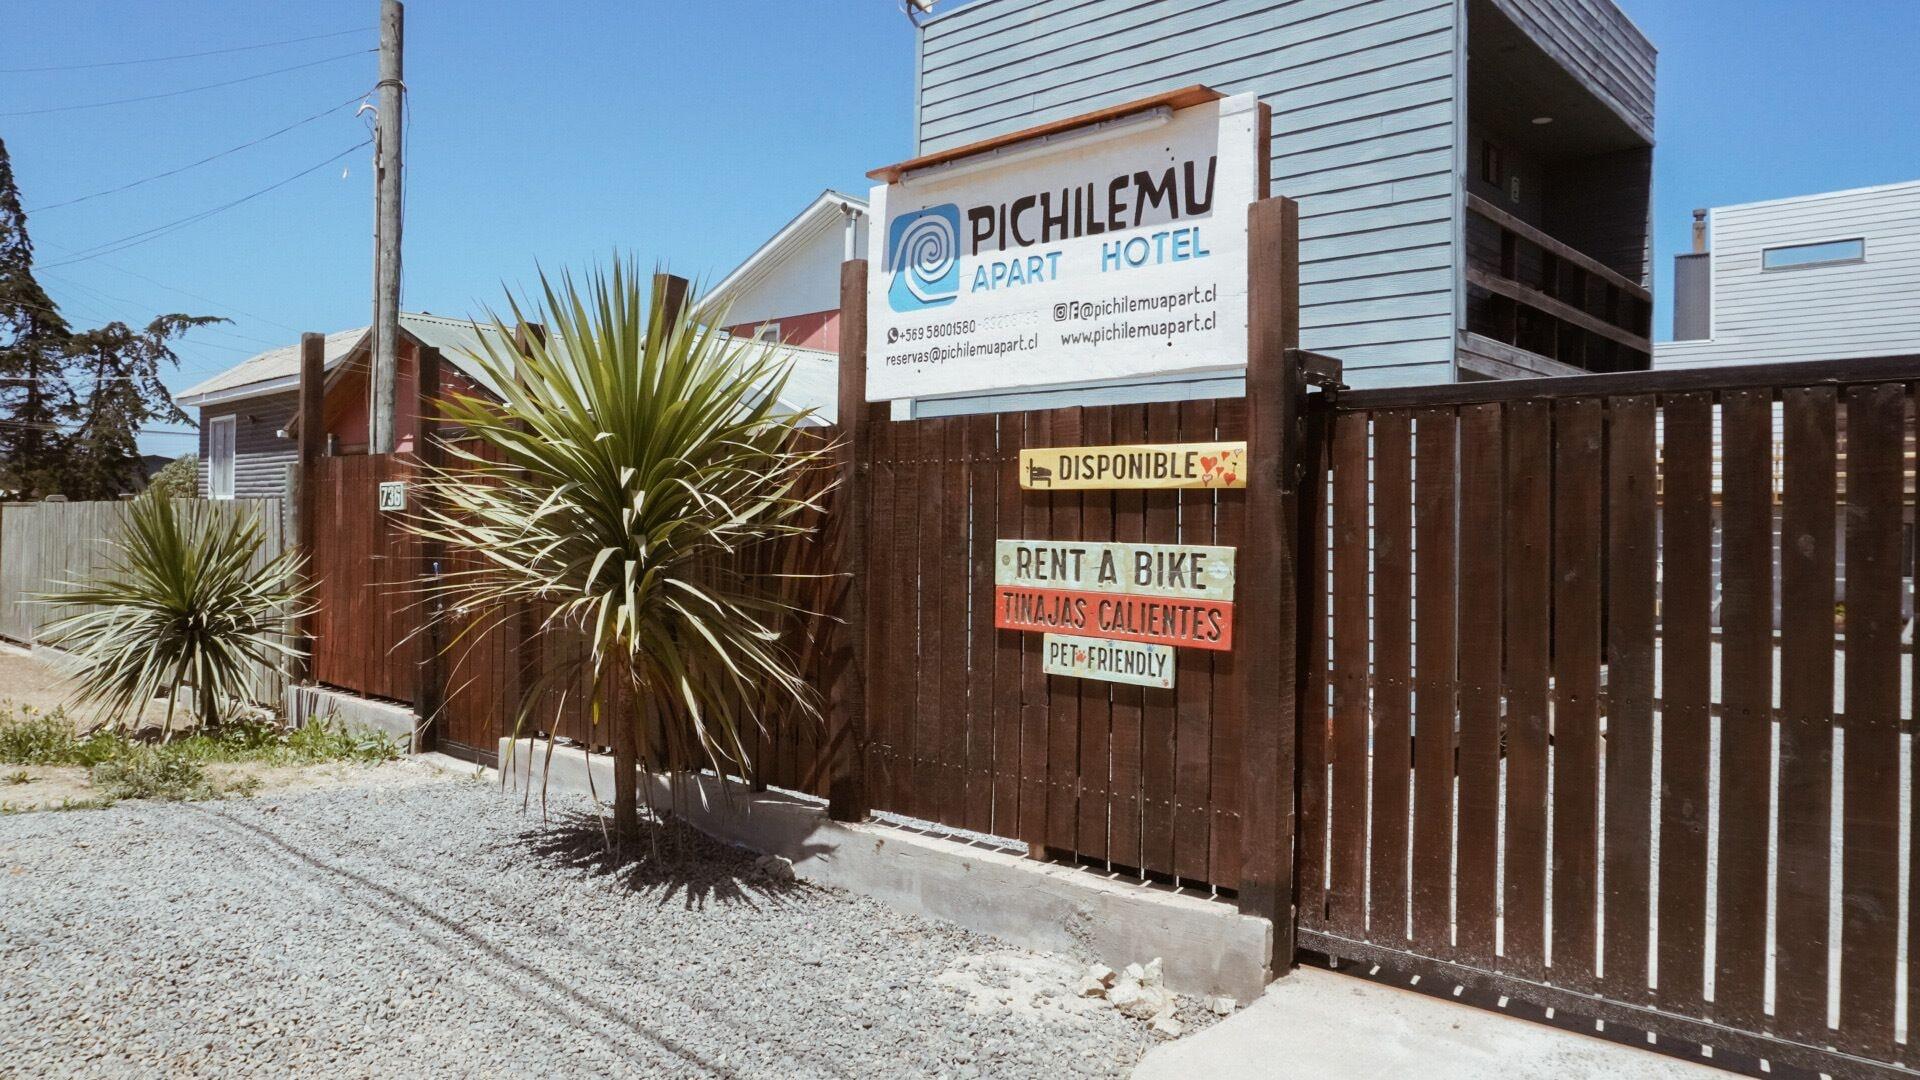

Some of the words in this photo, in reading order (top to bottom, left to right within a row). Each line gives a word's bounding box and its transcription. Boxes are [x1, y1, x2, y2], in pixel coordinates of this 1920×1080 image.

[967, 155, 1217, 256] PICHILEMU
[971, 251, 1063, 293] APART
[1101, 226, 1210, 272] HOTEL
[899, 327, 924, 342] +569
[926, 319, 976, 339] 58001580
[1061, 311, 1216, 346] www.pichilemuapart.cl
[886, 332, 1038, 366] reservas@pichilemuapart.cl
[1058, 451, 1199, 481] DISPONIBLE
[381, 484, 402, 507] 736
[1015, 546, 1086, 582] RENT
[1097, 549, 1118, 586] A
[1134, 551, 1207, 590] BIKE
[1003, 592, 1088, 630] TINAJAS
[1099, 600, 1222, 643] CALIENTES
[1050, 642, 1078, 668] PET
[1087, 646, 1167, 678] FRIENDLY
